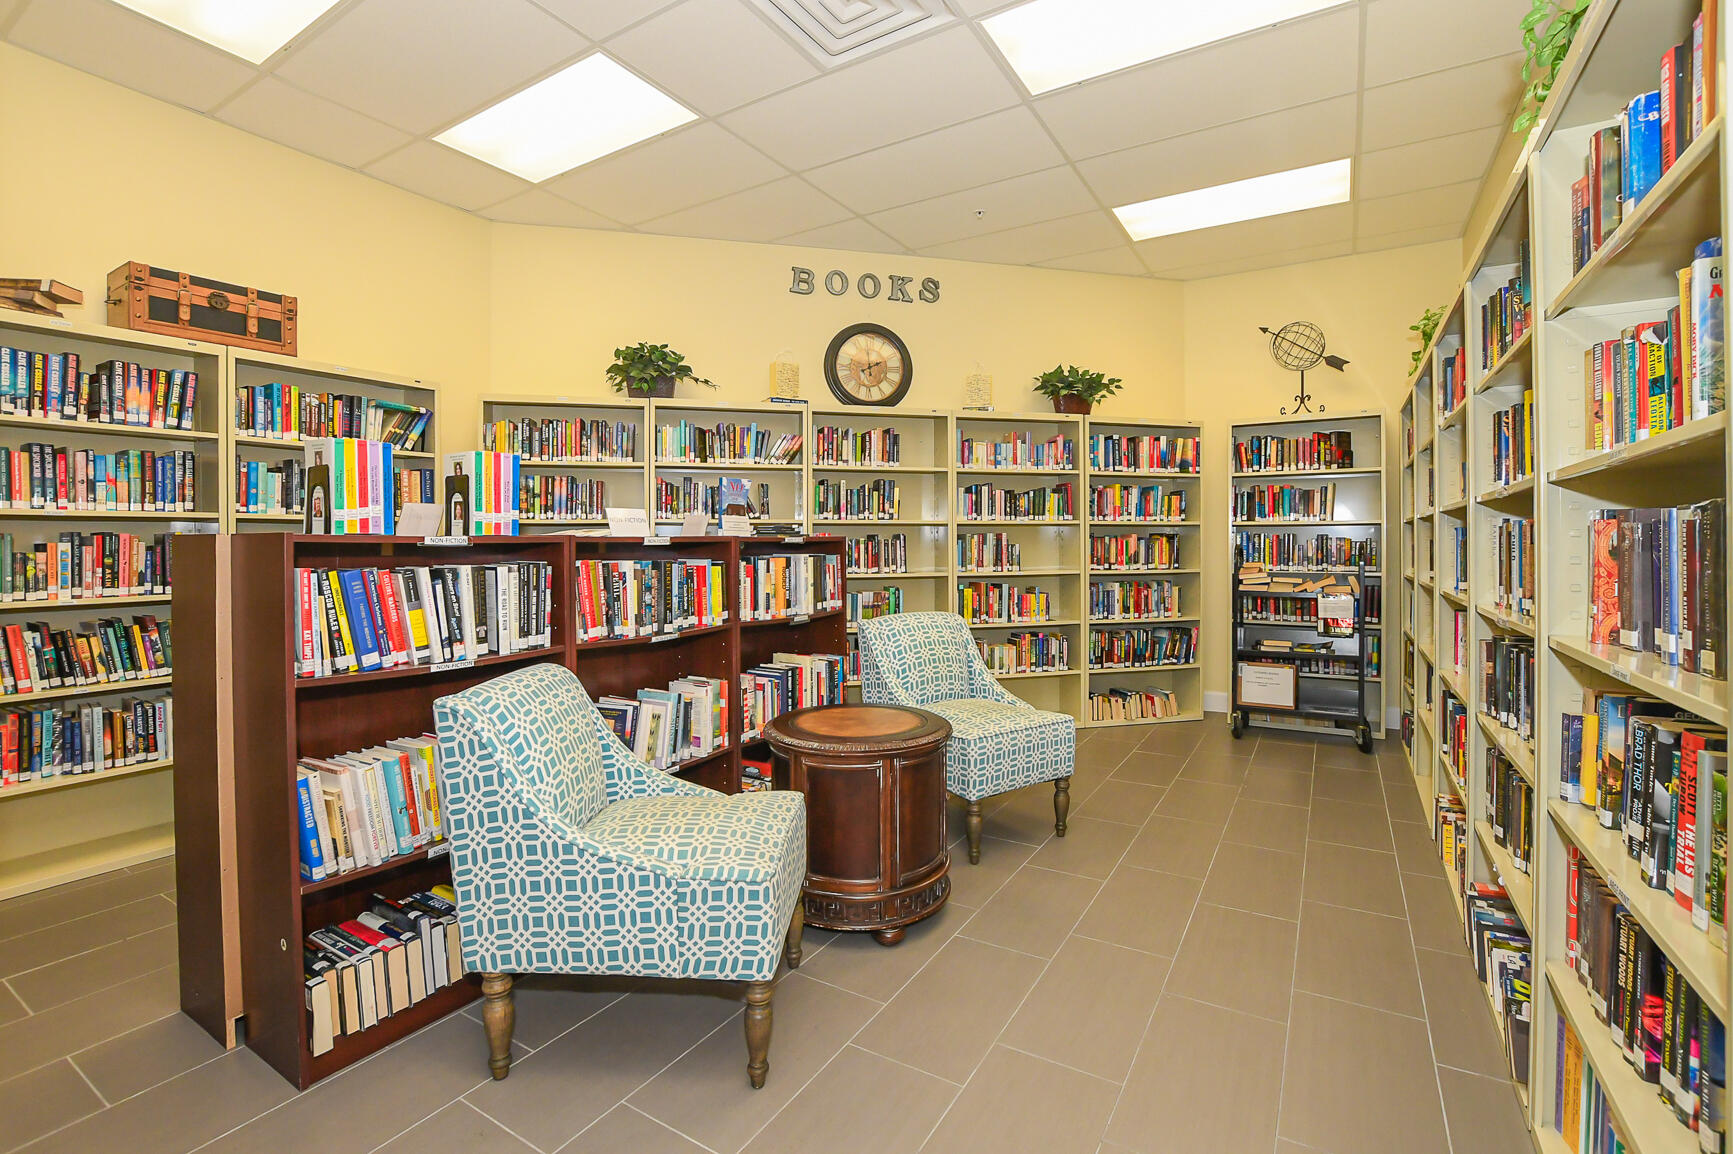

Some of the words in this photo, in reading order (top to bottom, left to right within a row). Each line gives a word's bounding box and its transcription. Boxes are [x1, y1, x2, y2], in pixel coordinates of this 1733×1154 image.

[789, 266, 940, 303] BOOKS
[1657, 355, 1663, 364] OF
[624, 516, 647, 524] FICTION
[430, 537, 468, 545] NON-FICTION
[323, 580, 334, 608] MOSCOW
[383, 574, 392, 596] CULTURE
[327, 609, 339, 630] RULES
[387, 596, 398, 622] WARLORDS
[303, 630, 312, 642] KAT
[436, 661, 473, 670] NON-FICTION
[1633, 729, 1644, 761] BRAD
[1632, 761, 1643, 791] THOR
[1647, 764, 1655, 793] Towles
[1679, 770, 1688, 816] TUROW
[1687, 775, 1697, 818] SCOTT
[1631, 798, 1639, 821] PROJE
[1676, 829, 1685, 865] TRIAL
[1685, 823, 1696, 849] THE
[1684, 849, 1695, 875] LAS
[1619, 919, 1628, 954] STUART
[1628, 930, 1636, 961] STUART
[1617, 954, 1627, 989] WOODS
[1627, 961, 1635, 992] WOODS
[1666, 966, 1674, 1001] STUART
[1664, 1001, 1673, 1036] WOODS
